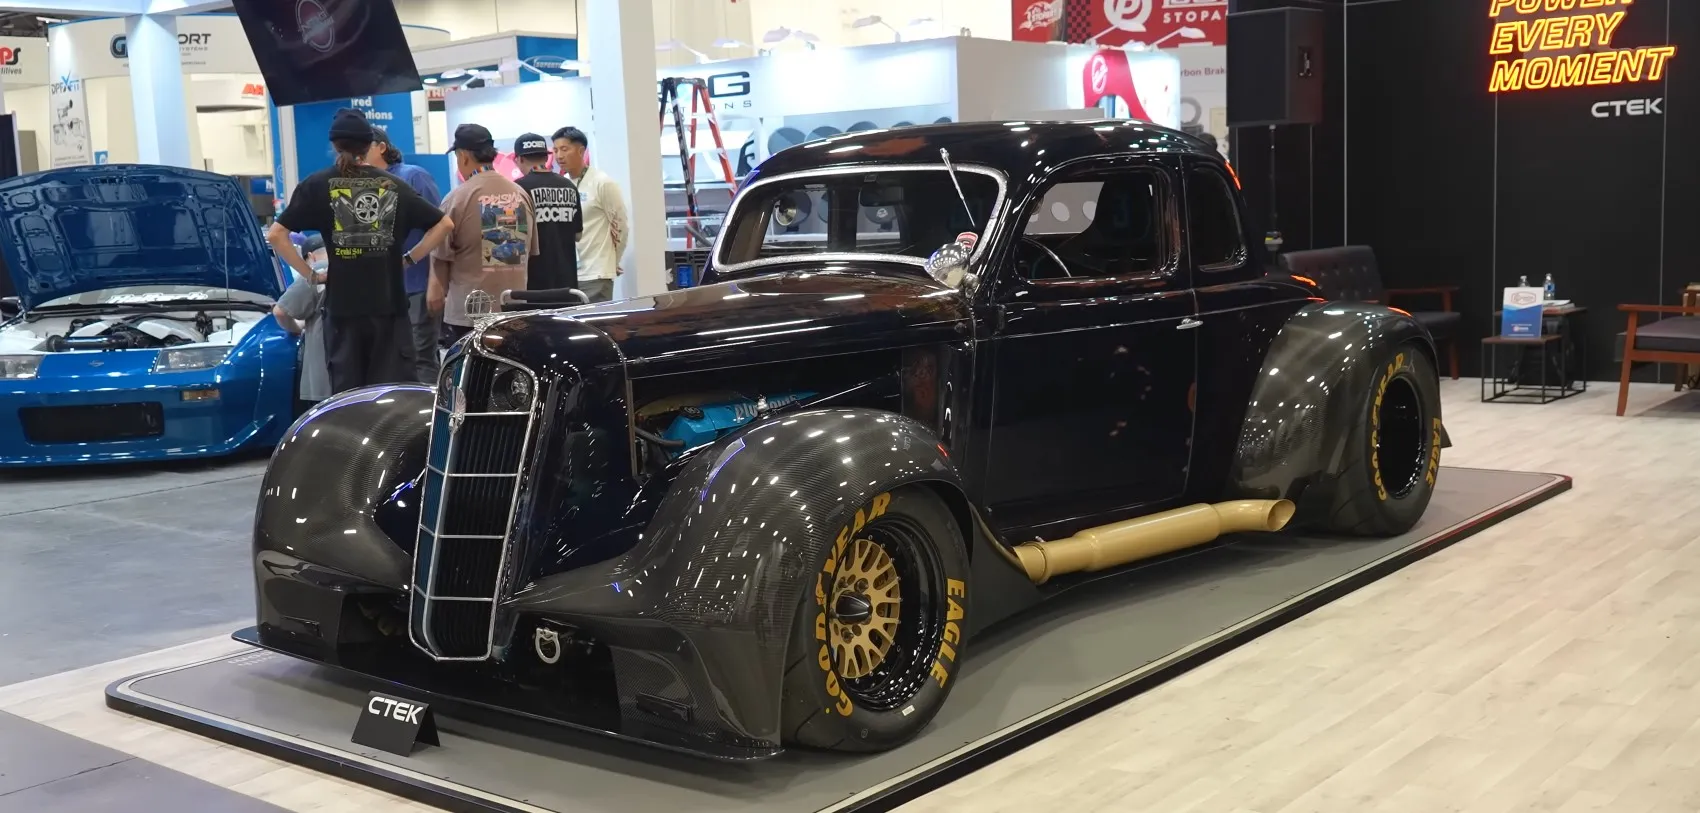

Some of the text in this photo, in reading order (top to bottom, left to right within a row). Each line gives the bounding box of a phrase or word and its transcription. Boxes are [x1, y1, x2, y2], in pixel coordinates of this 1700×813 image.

[1163, 9, 1228, 25] STOPA
[1489, 11, 1626, 54] EVERY
[1488, 46, 1675, 92] MOMENT
[1591, 97, 1663, 118] CTEK
[929, 578, 965, 689] EAGLE
[368, 696, 424, 725] CTEK
